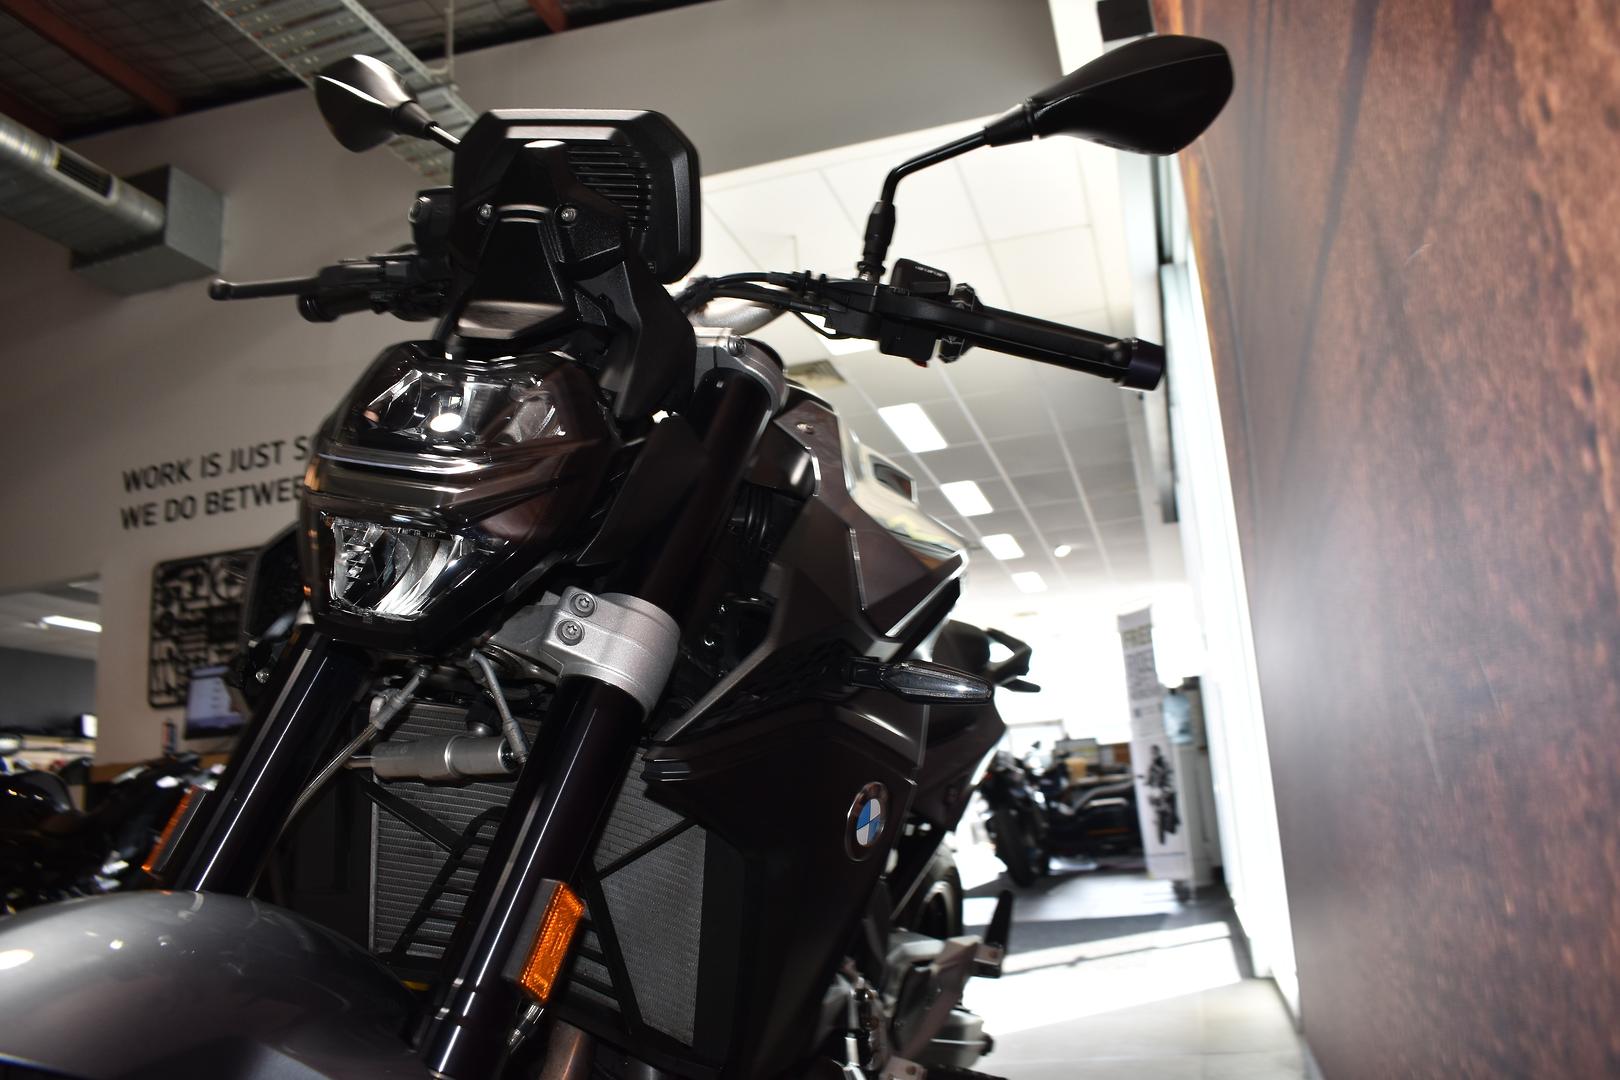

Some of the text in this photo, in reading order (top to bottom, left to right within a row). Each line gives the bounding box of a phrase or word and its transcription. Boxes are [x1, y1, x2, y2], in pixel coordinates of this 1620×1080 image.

[122, 459, 192, 493] WORK
[200, 452, 222, 480] IS
[228, 440, 286, 474] JUST
[120, 474, 305, 530] WE DO BETWEE
